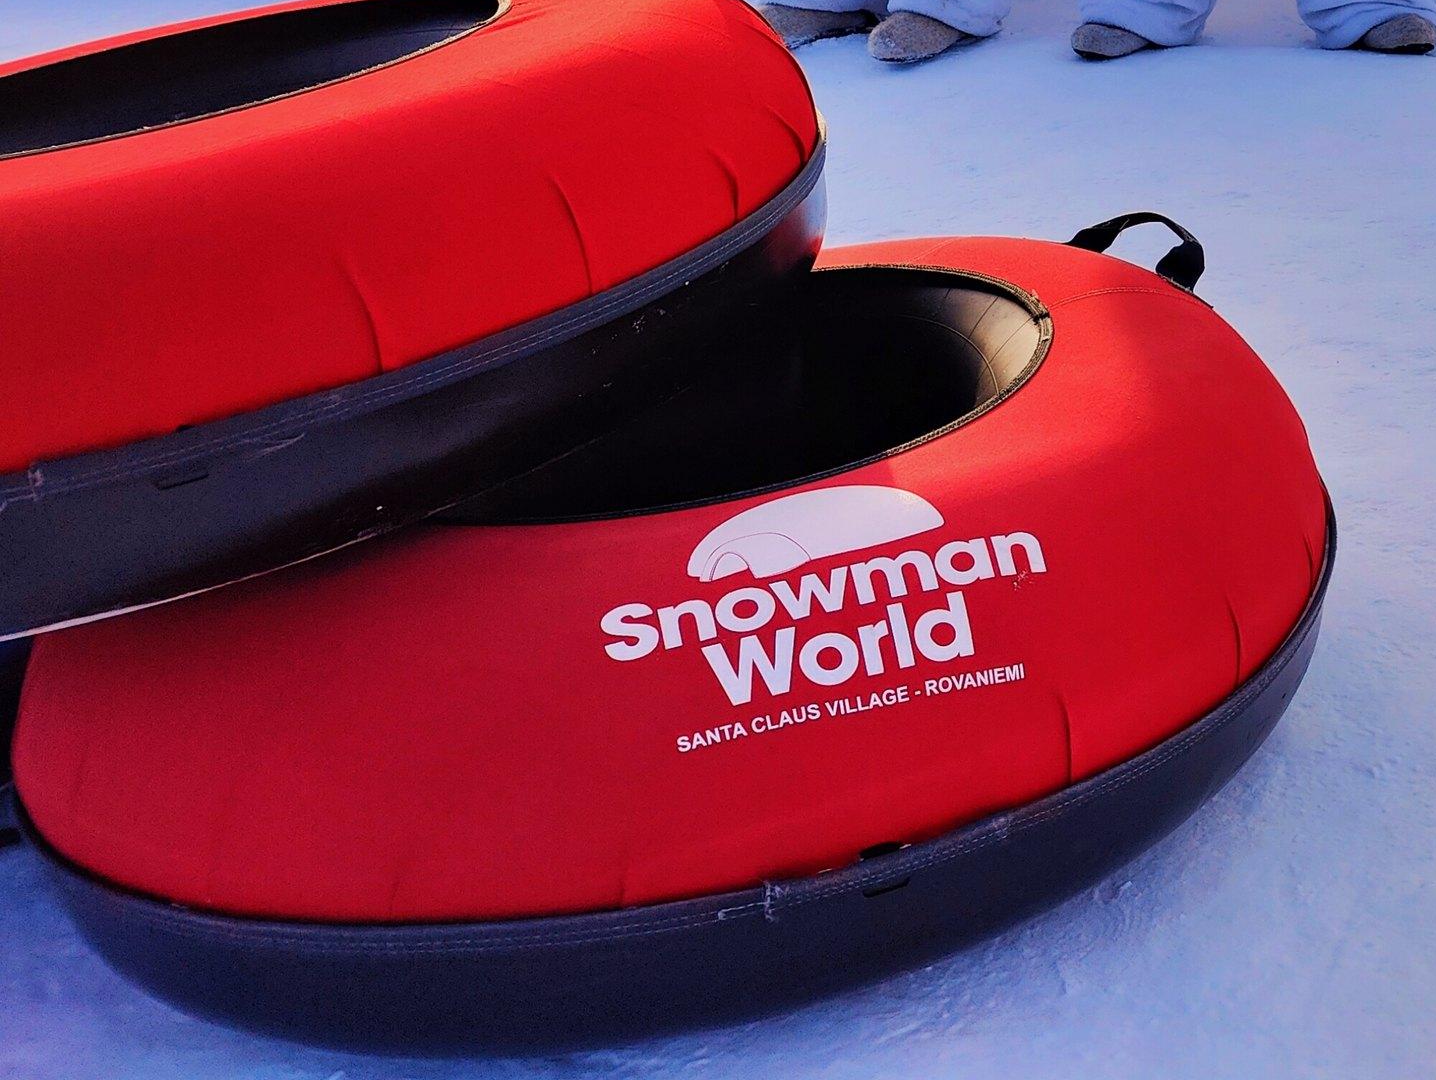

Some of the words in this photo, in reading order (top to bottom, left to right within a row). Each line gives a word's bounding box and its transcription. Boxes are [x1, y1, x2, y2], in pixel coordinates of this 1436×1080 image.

[700, 590, 975, 707] World
[676, 722, 748, 753] SANTA
[751, 703, 821, 733] CLAUS
[825, 686, 910, 717] VILLAGE
[925, 662, 1025, 697] ROVANIEMI
